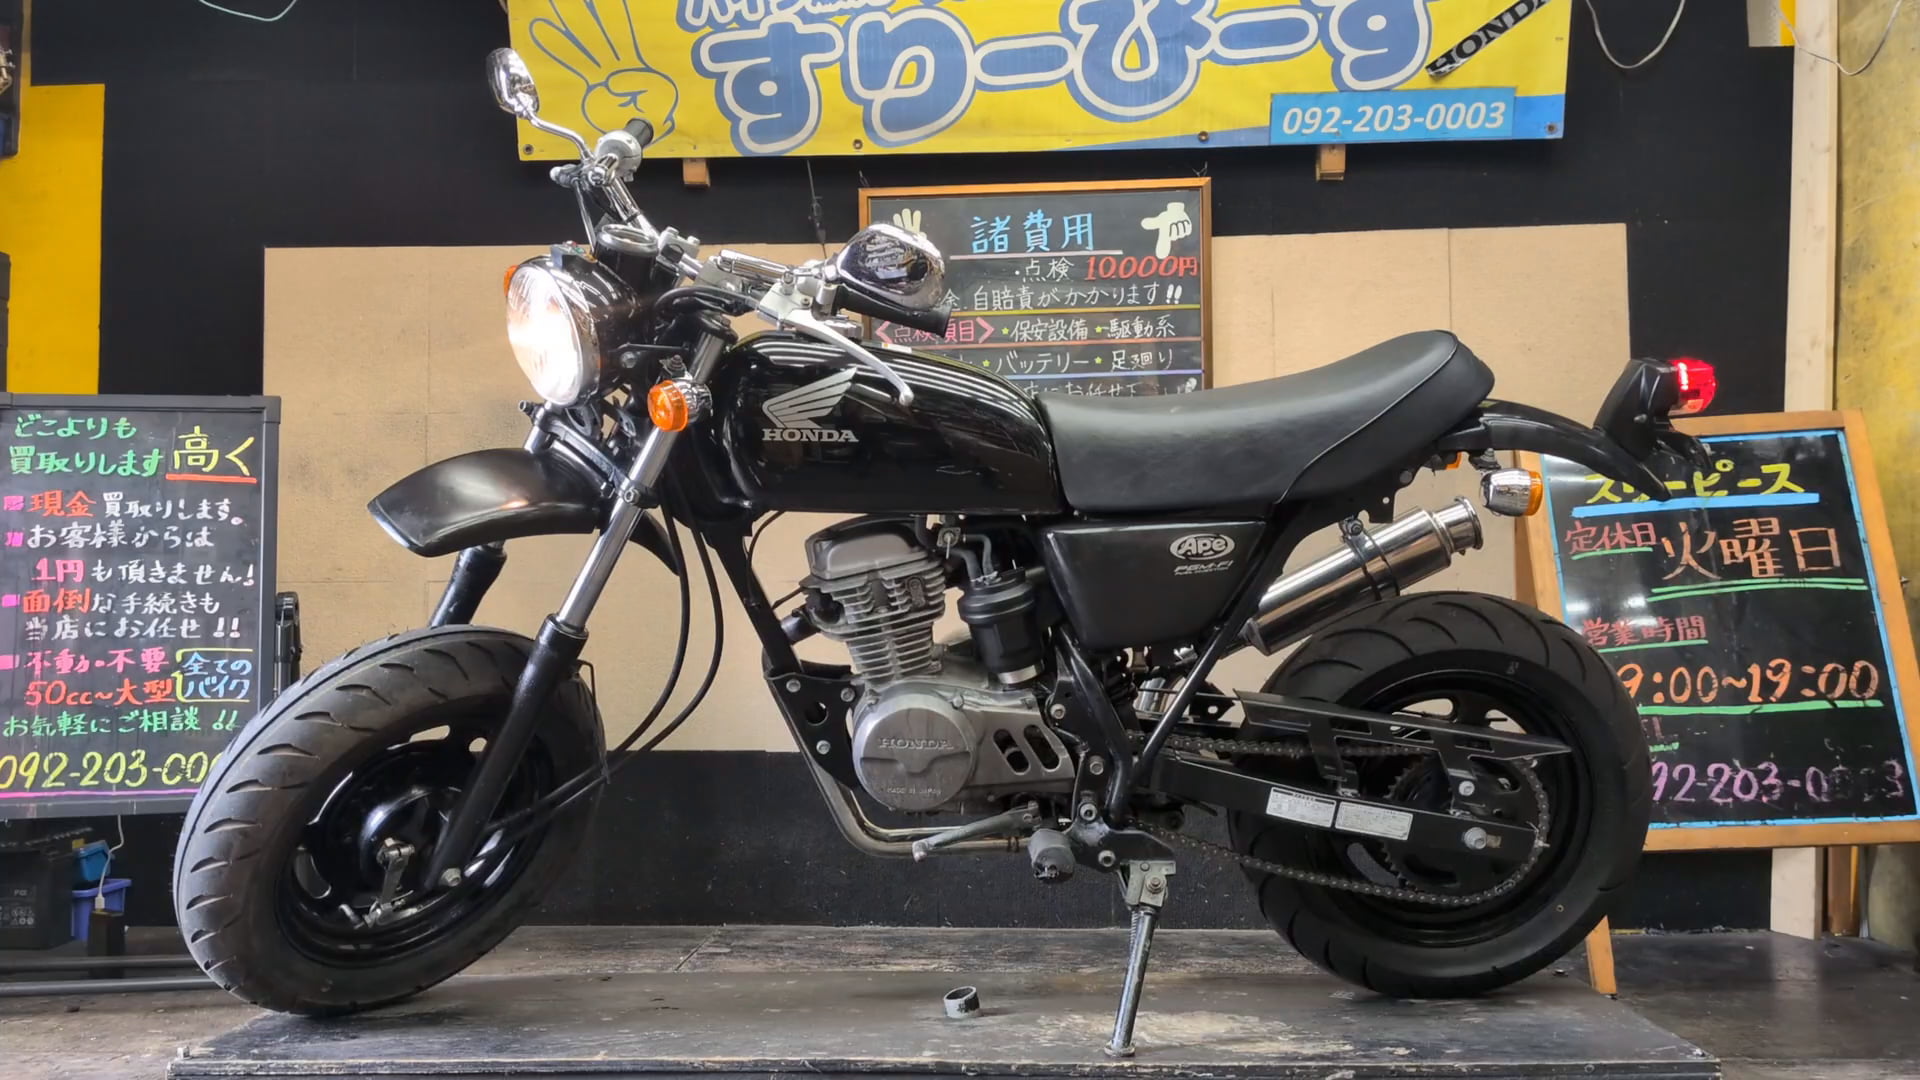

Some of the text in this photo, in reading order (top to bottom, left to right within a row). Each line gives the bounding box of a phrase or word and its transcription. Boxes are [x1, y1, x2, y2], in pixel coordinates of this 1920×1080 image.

[1281, 102, 1507, 136] 092-203-0003
[970, 209, 1093, 253] 諸費用
[1010, 319, 1089, 343] 保安設備
[15, 414, 136, 440] どこよりも
[762, 429, 859, 442] HONDA
[9, 445, 164, 477] 買取りします
[173, 426, 255, 476] 高く
[27, 519, 215, 549] お客様からは
[1564, 517, 1841, 580] 定休日 火曜日
[23, 588, 220, 614] 面倒な手続きも
[1583, 615, 1707, 647] 営業時間
[182, 652, 252, 676] 全ての
[184, 674, 250, 699] バイク
[879, 737, 955, 749] HONDA
[0, 749, 222, 790] 092-203-00
